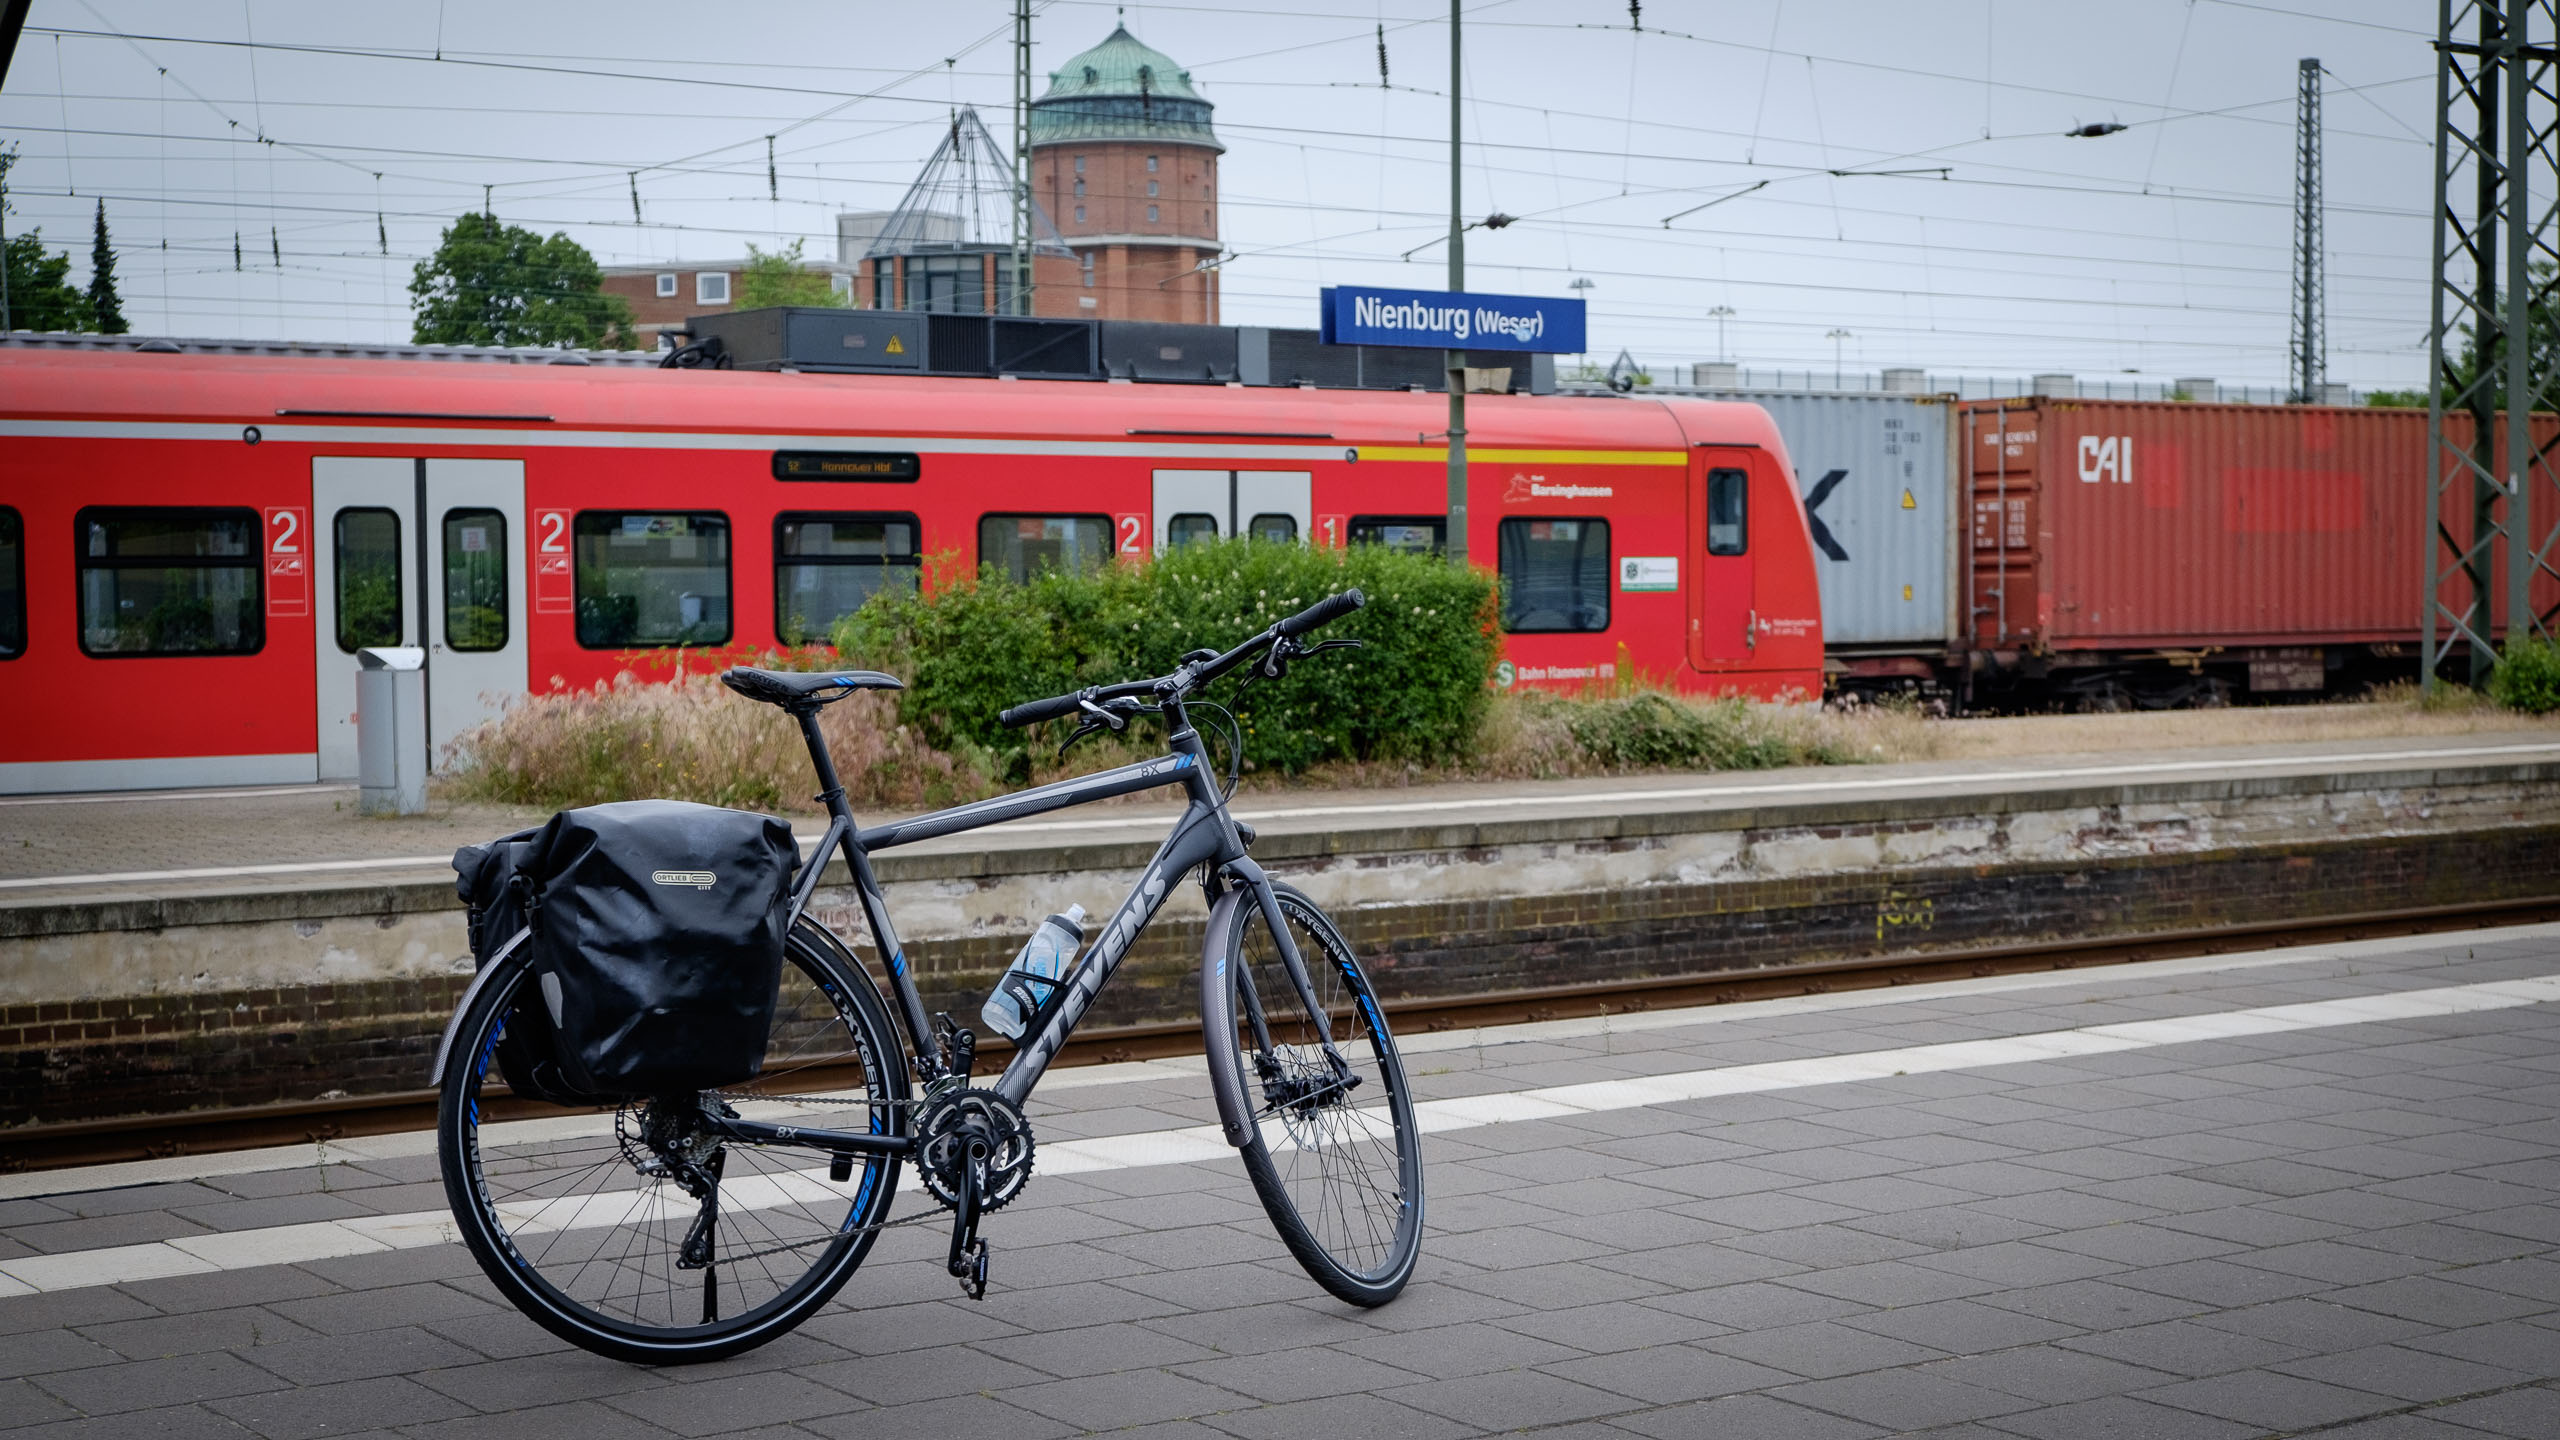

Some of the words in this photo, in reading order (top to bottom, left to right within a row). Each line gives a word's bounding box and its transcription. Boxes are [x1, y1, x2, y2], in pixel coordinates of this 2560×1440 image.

[1354, 296, 1470, 339] Nienburg
[1474, 307, 1544, 338] (Weser)
[2078, 435, 2133, 483] CAI
[272, 511, 299, 553] 2
[540, 513, 565, 553] 2
[1120, 516, 1141, 553] 2
[1519, 666, 1546, 680] Bahn
[1140, 763, 1160, 778] 8X
[1288, 904, 1341, 957] OXYGEN
[1025, 864, 1167, 1084] STEVENS
[832, 991, 880, 1105] OXYGEN
[775, 1126, 799, 1140] 8X
[974, 1161, 986, 1191] XT
[469, 1140, 517, 1259] OXYGEN
